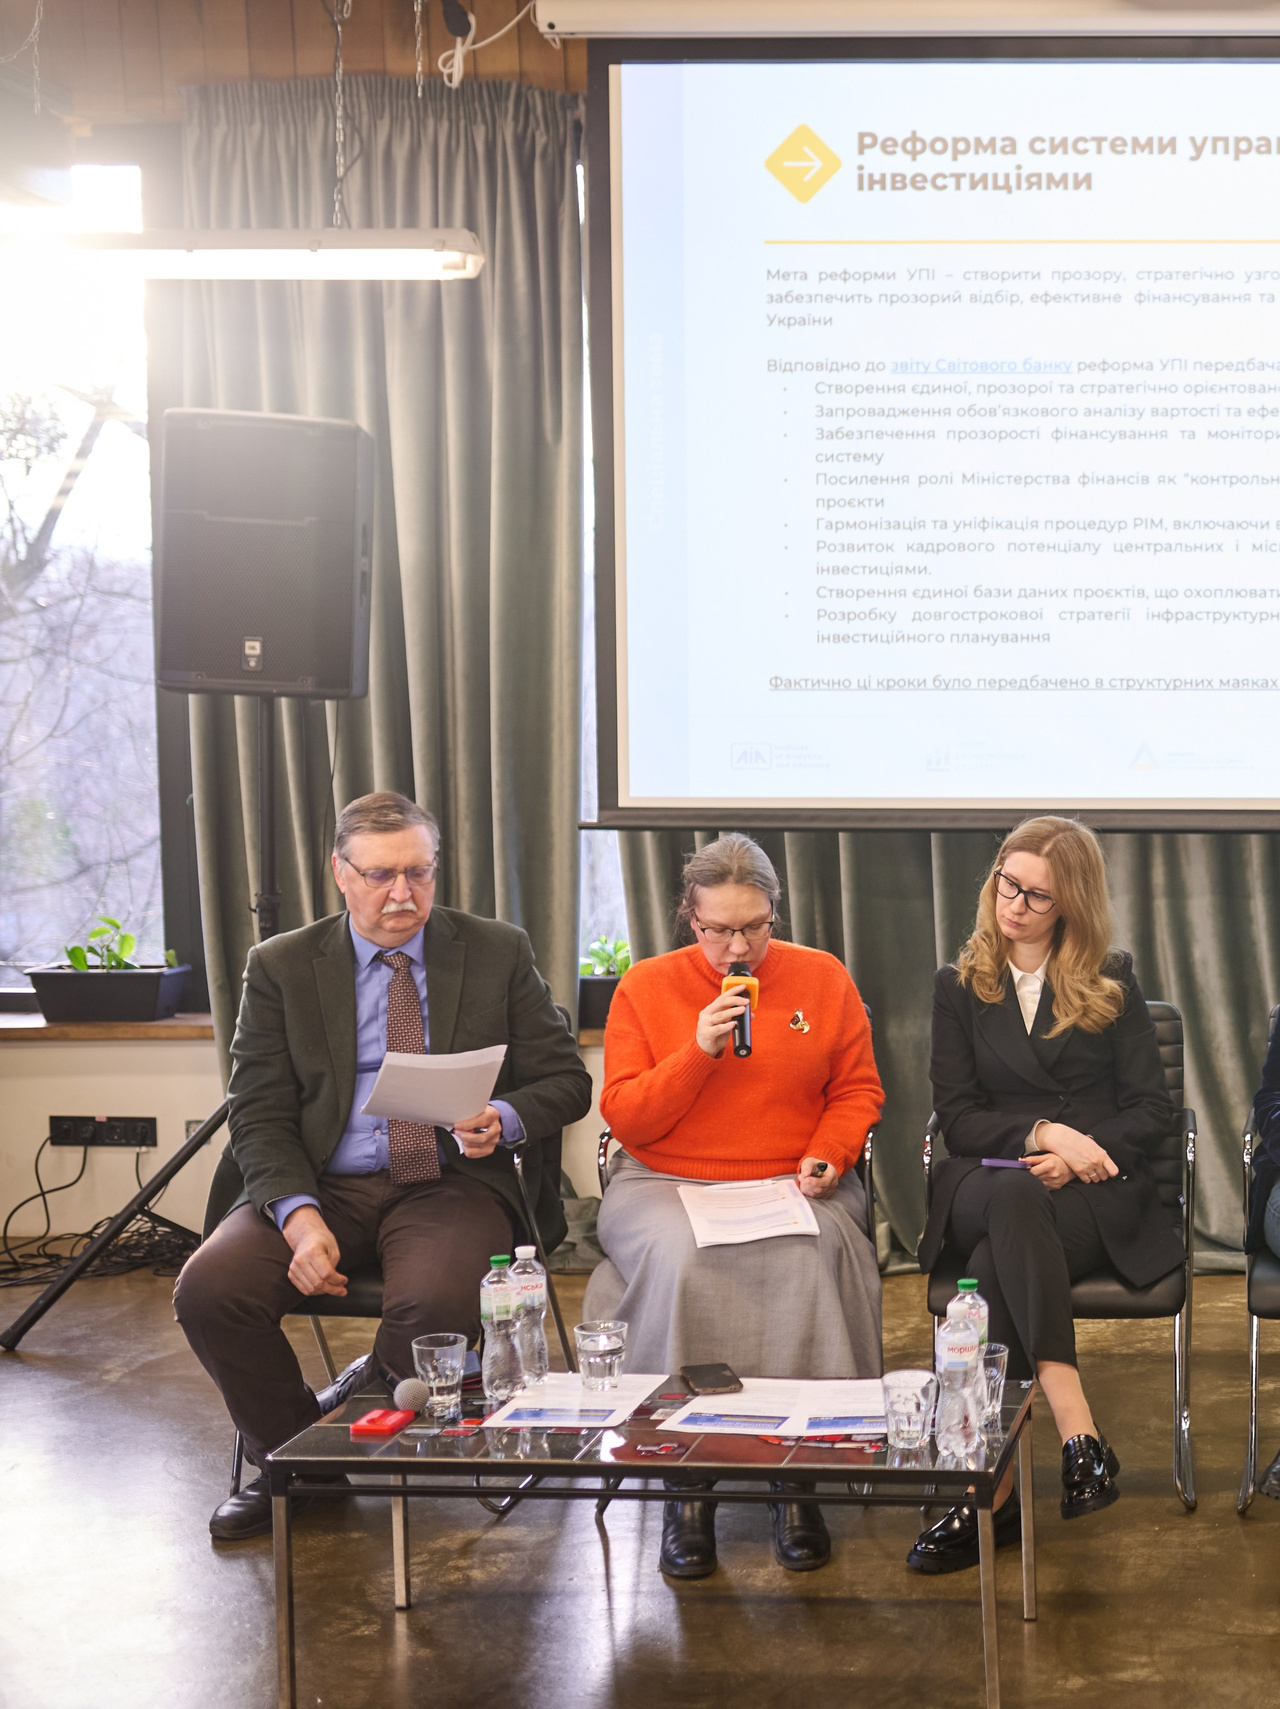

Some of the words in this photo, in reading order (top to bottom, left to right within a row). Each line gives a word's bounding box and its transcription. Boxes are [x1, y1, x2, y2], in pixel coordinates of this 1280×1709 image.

[857, 130, 1018, 162] Реформа
[1028, 136, 1177, 156] системи
[856, 160, 1092, 195] інвестиціями
[767, 269, 808, 281] Мета
[818, 268, 896, 284] реформи
[907, 268, 935, 281] УПІ
[963, 271, 1041, 283] створити
[1051, 271, 1126, 283] прозору,
[1136, 267, 1235, 283] стратегічно
[766, 290, 873, 304] забезпечить
[878, 290, 962, 307] прозорий
[969, 289, 1024, 306] відбір,
[1030, 291, 1122, 306] ефективне
[1134, 290, 1251, 306] фінансування
[766, 313, 833, 329] України
[767, 358, 861, 374] Відповідно
[865, 362, 886, 373] до
[891, 358, 931, 375] звіту
[935, 358, 1018, 374] Світового
[1022, 357, 1073, 375] банку
[1077, 358, 1154, 374] реформа
[1159, 358, 1188, 371] УПІ
[815, 381, 906, 397] Створення
[911, 381, 971, 396] єдиної,
[977, 381, 1053, 397] прозорої
[1080, 381, 1179, 397] стратегічно
[815, 405, 952, 420] Запровадження
[1083, 404, 1146, 420] аналізу
[1151, 404, 1220, 420] вартості
[815, 426, 936, 440] Забезпечення
[946, 427, 1040, 443] прозорості
[1051, 426, 1168, 443] фінансування
[815, 452, 884, 466] систему
[816, 472, 909, 486] Посилення
[918, 472, 953, 488] ролі
[962, 472, 1070, 488] Міністерства
[1078, 472, 1150, 488] фінансів
[1157, 475, 1176, 485] як
[816, 497, 884, 511] проєкти
[816, 517, 926, 533] Гармонізація
[953, 516, 1039, 533] уніфікація
[1045, 520, 1128, 533] процедур
[1173, 520, 1270, 530] включаючи
[816, 540, 895, 553] Розвиток
[907, 542, 995, 555] кадрового
[1008, 539, 1101, 556] потенціалу
[1113, 542, 1224, 555] центральних
[816, 562, 932, 577] інвестиціями.
[816, 585, 907, 602] Створення
[912, 585, 968, 600] єдиної
[973, 584, 1012, 598] бази
[1017, 588, 1068, 600] даних
[1073, 585, 1149, 601] проєктів,
[1154, 588, 1179, 600] що
[817, 607, 898, 624] Розробку
[911, 608, 1043, 624] довгострокової
[1059, 608, 1131, 623] стратегії
[817, 630, 945, 645] інвестиційного
[950, 633, 1050, 646] планування
[769, 675, 852, 690] Фактично
[857, 675, 871, 690] ці
[877, 678, 927, 690] кроки
[932, 674, 972, 690] було
[977, 674, 1090, 690] передбачено
[1108, 678, 1213, 690] структурних
[1219, 678, 1278, 688] маяках
